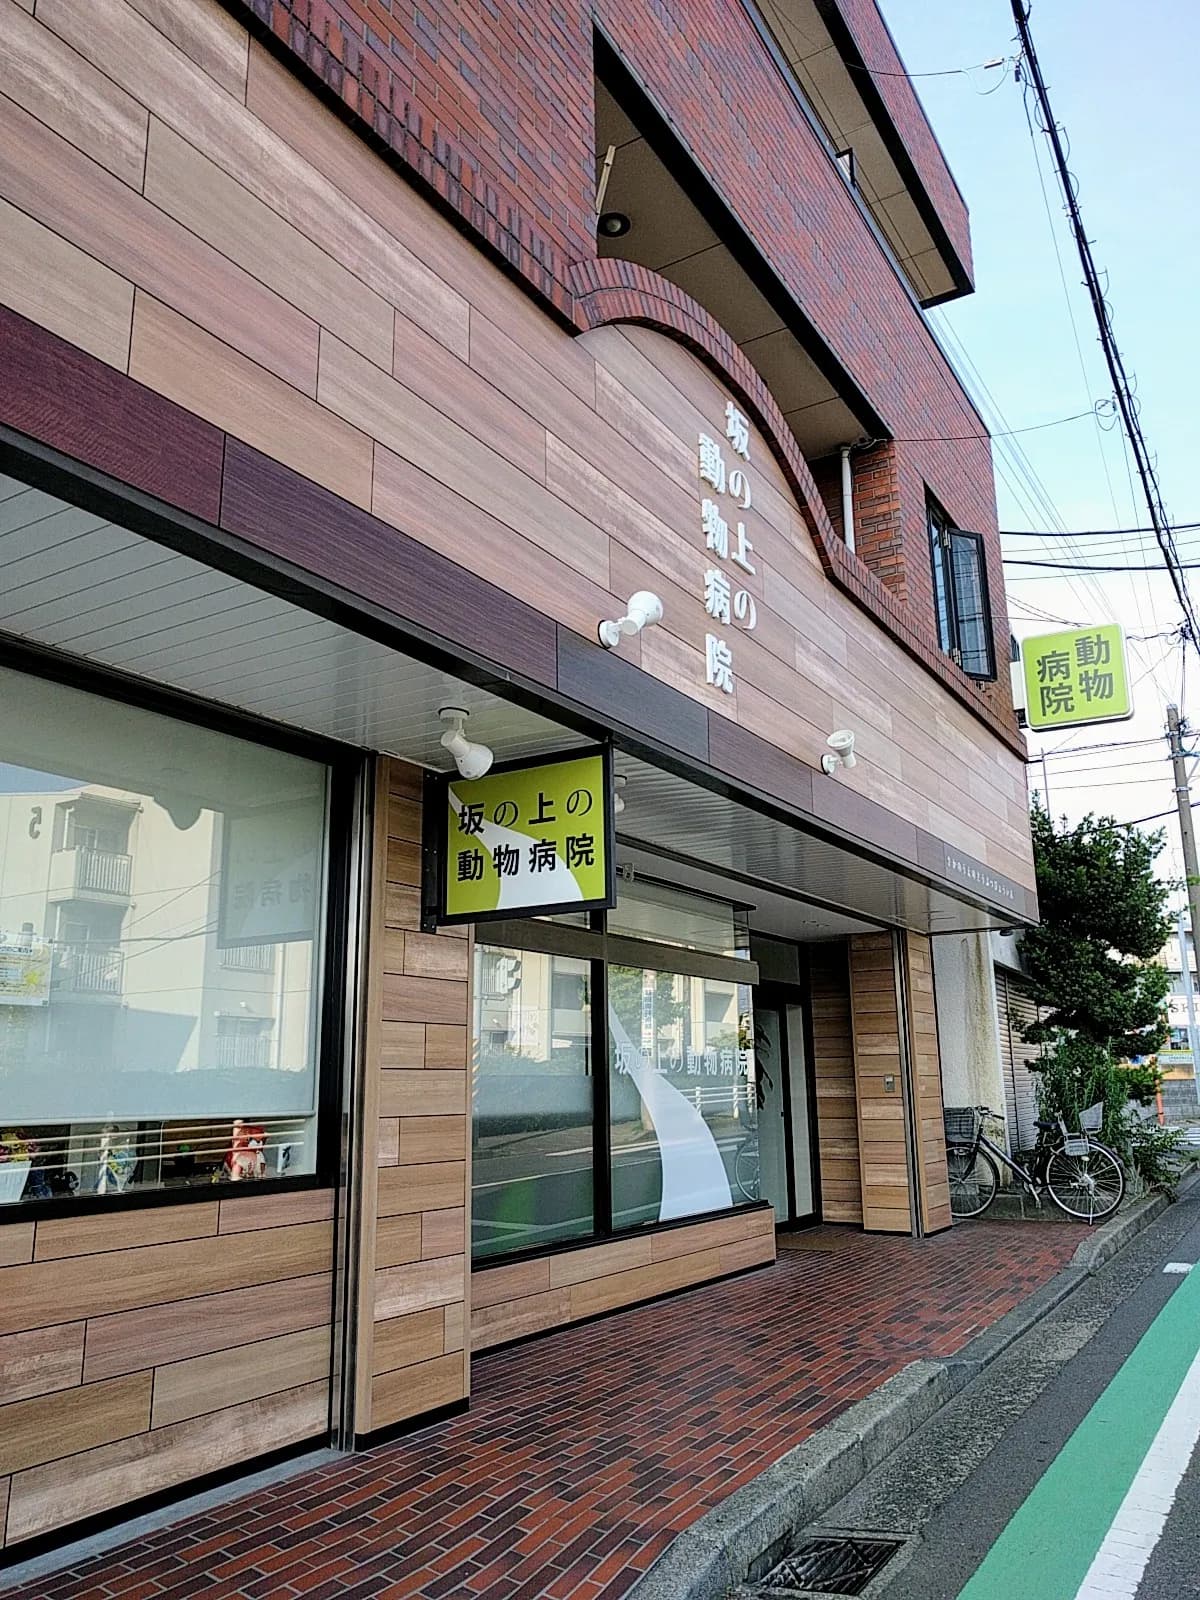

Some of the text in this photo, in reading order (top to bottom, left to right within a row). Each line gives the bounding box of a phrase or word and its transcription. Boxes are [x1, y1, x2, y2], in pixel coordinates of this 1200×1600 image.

[725, 401, 756, 630] 坂の上の
[698, 432, 733, 694] 動物病院
[1037, 650, 1075, 717] 病院
[1075, 634, 1114, 702] 動物
[458, 789, 593, 835] 坂の上の
[457, 833, 595, 882] 動物病院
